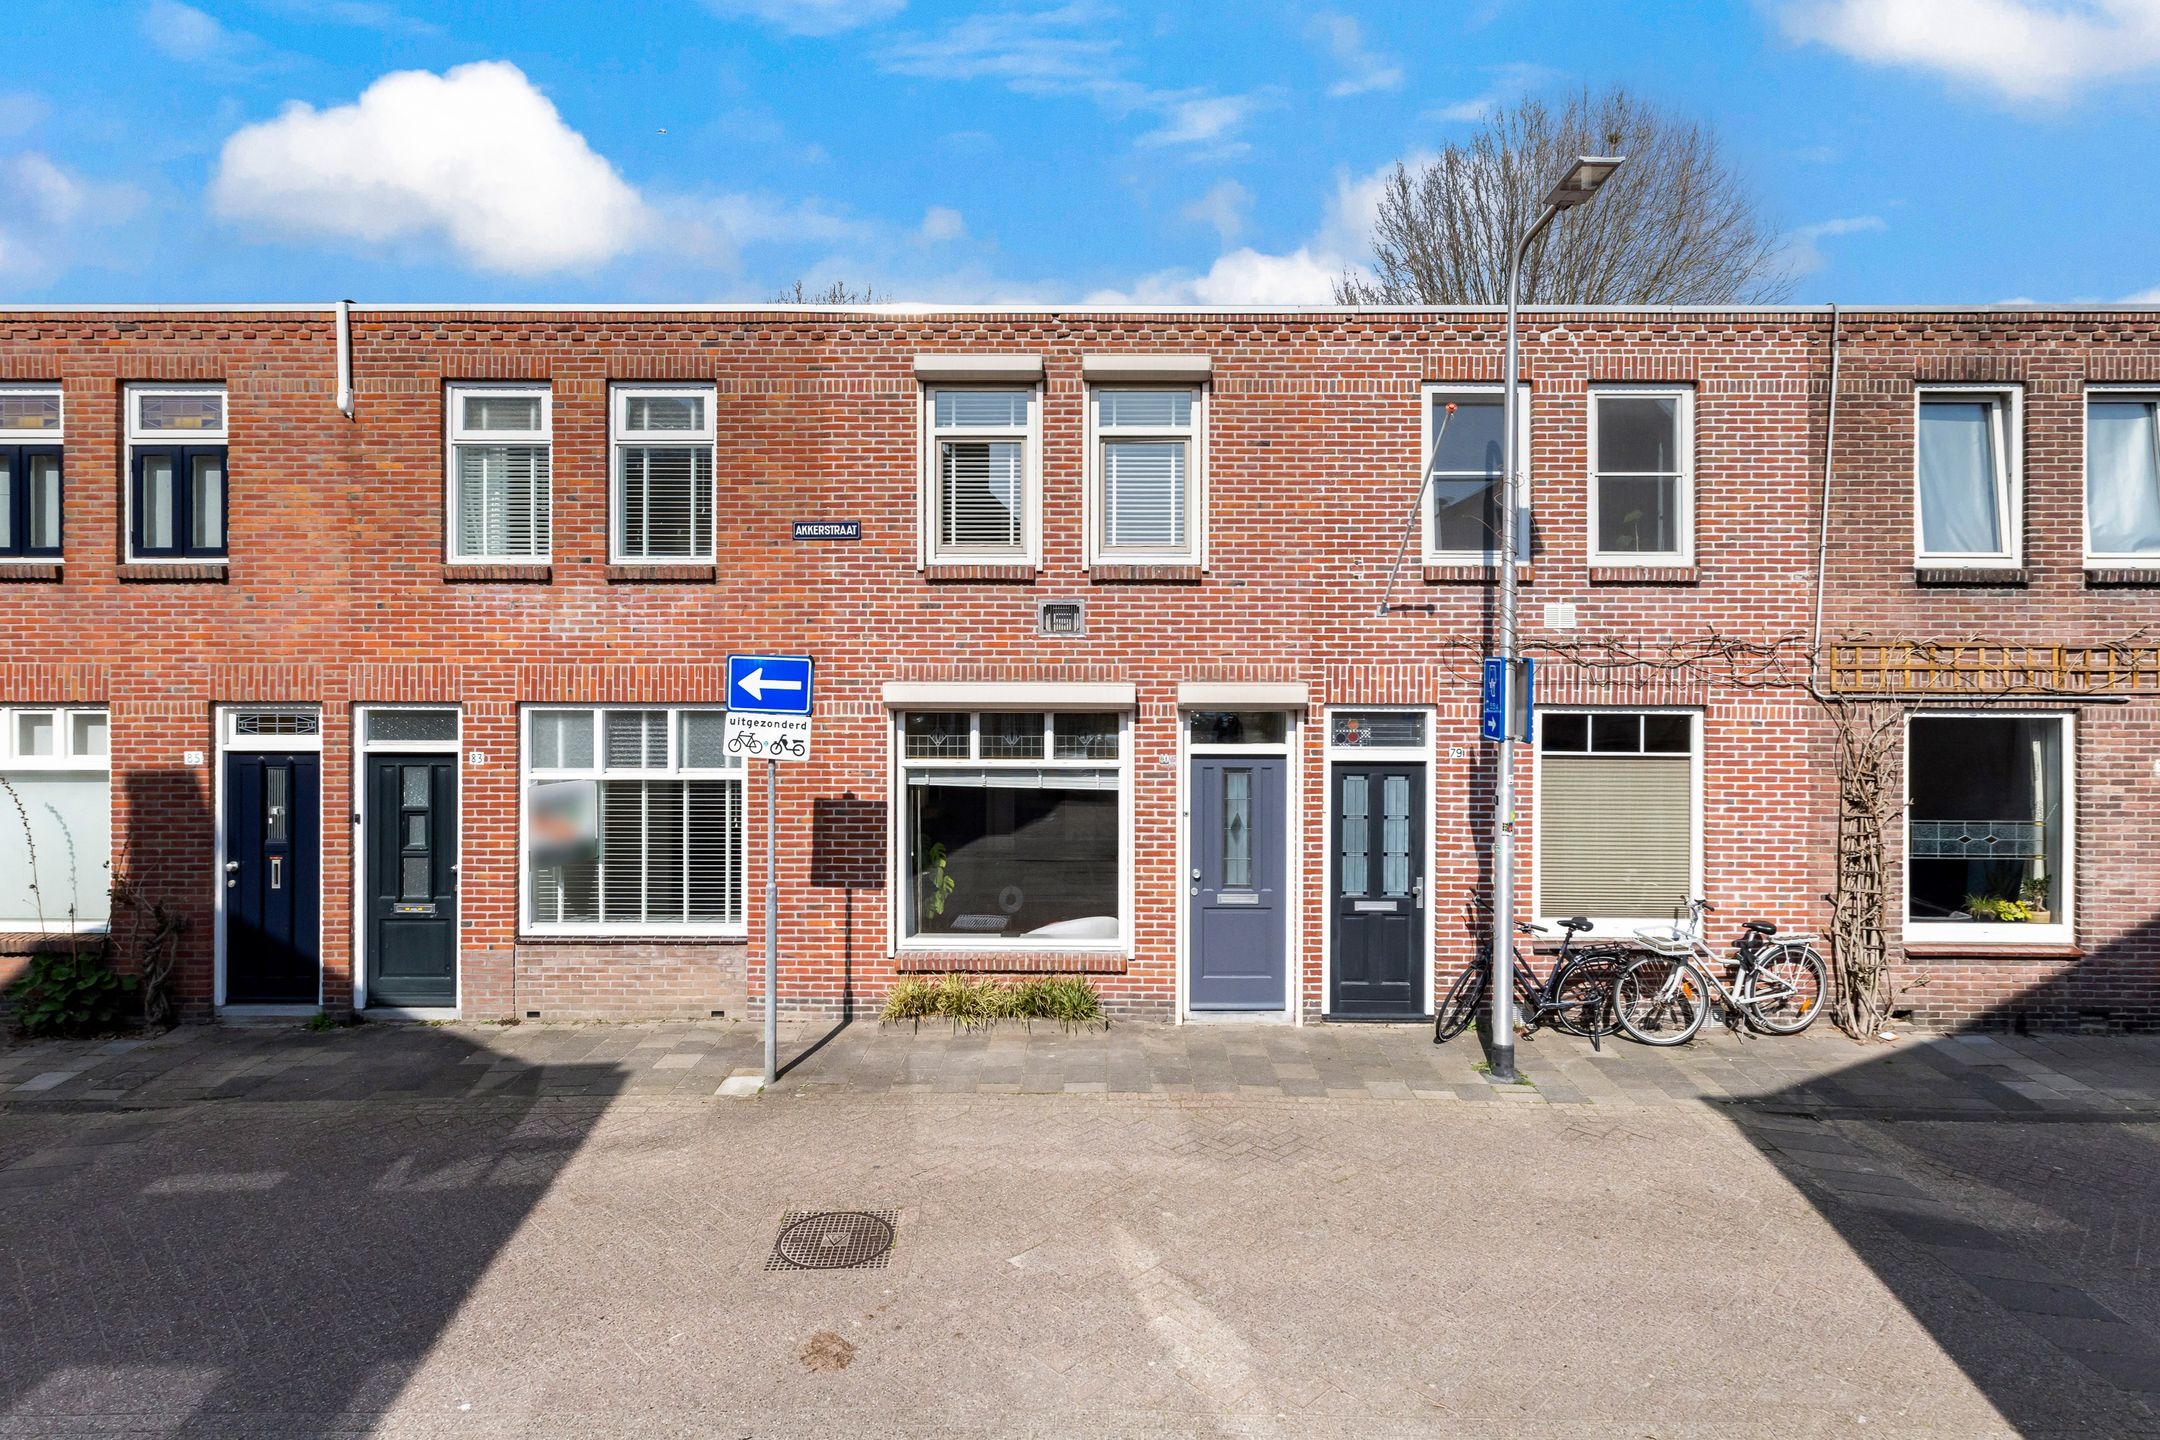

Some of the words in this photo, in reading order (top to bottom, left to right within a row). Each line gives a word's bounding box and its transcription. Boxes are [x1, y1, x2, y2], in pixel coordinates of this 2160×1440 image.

[795, 525, 858, 536] AKKERSTRAAT
[729, 717, 808, 730] uitgezonderd
[186, 753, 201, 764] 85
[471, 753, 483, 764] 83
[1450, 748, 1463, 758] 79
